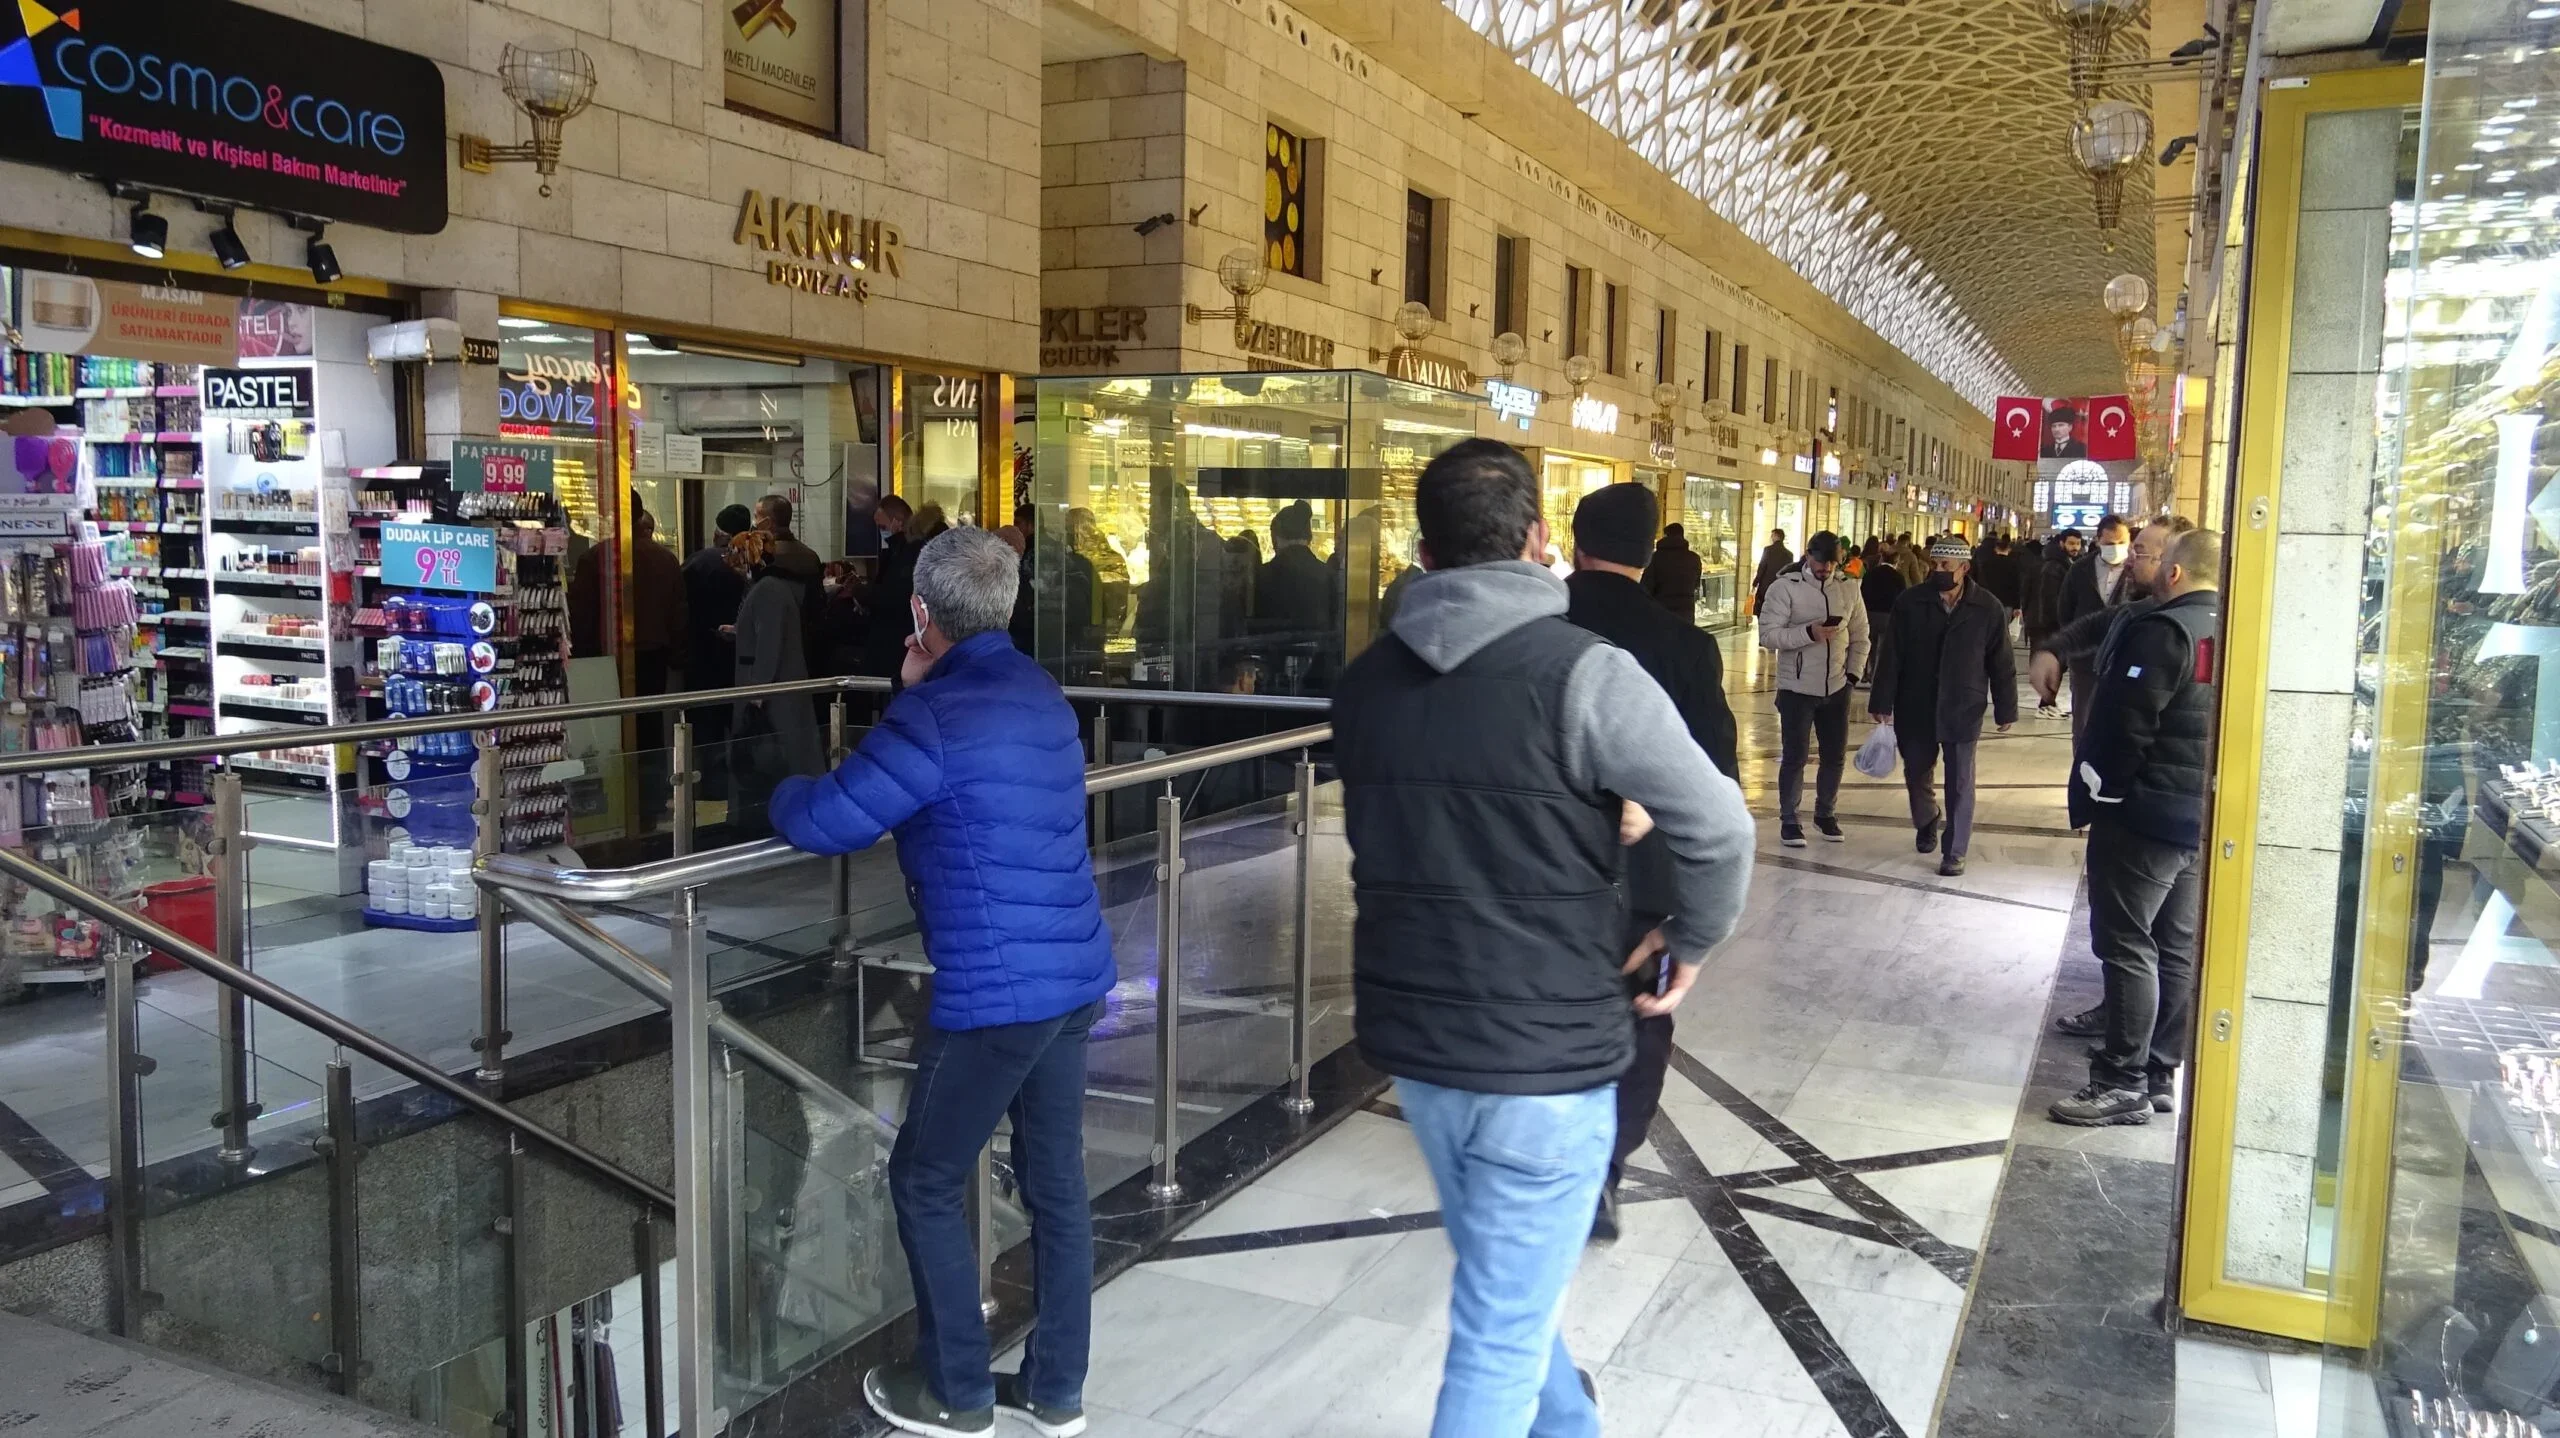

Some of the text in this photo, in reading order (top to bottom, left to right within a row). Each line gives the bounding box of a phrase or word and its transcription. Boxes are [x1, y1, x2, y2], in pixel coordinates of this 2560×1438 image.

[761, 61, 817, 93] MADENLER
[56, 38, 405, 156] cosmo&care
[187, 139, 207, 158] ve
[212, 139, 268, 171] Kişisel
[272, 153, 321, 181] Bakım
[733, 189, 904, 279] AKNUR
[111, 302, 230, 328] ÜRÜNLERİ BURADA
[239, 315, 277, 335] TEL
[1039, 306, 1147, 342] KLER
[119, 323, 222, 345] SATILMAKTADIR
[482, 345, 497, 358] 120
[1039, 345, 1120, 367] CULUK
[207, 376, 309, 408] PASTEL
[1210, 411, 1241, 428] ALTIN
[521, 448, 547, 462] OJE
[486, 463, 525, 484] 9.99
[386, 528, 489, 547] DUDAK LİP CARE
[441, 568, 462, 586] TL
